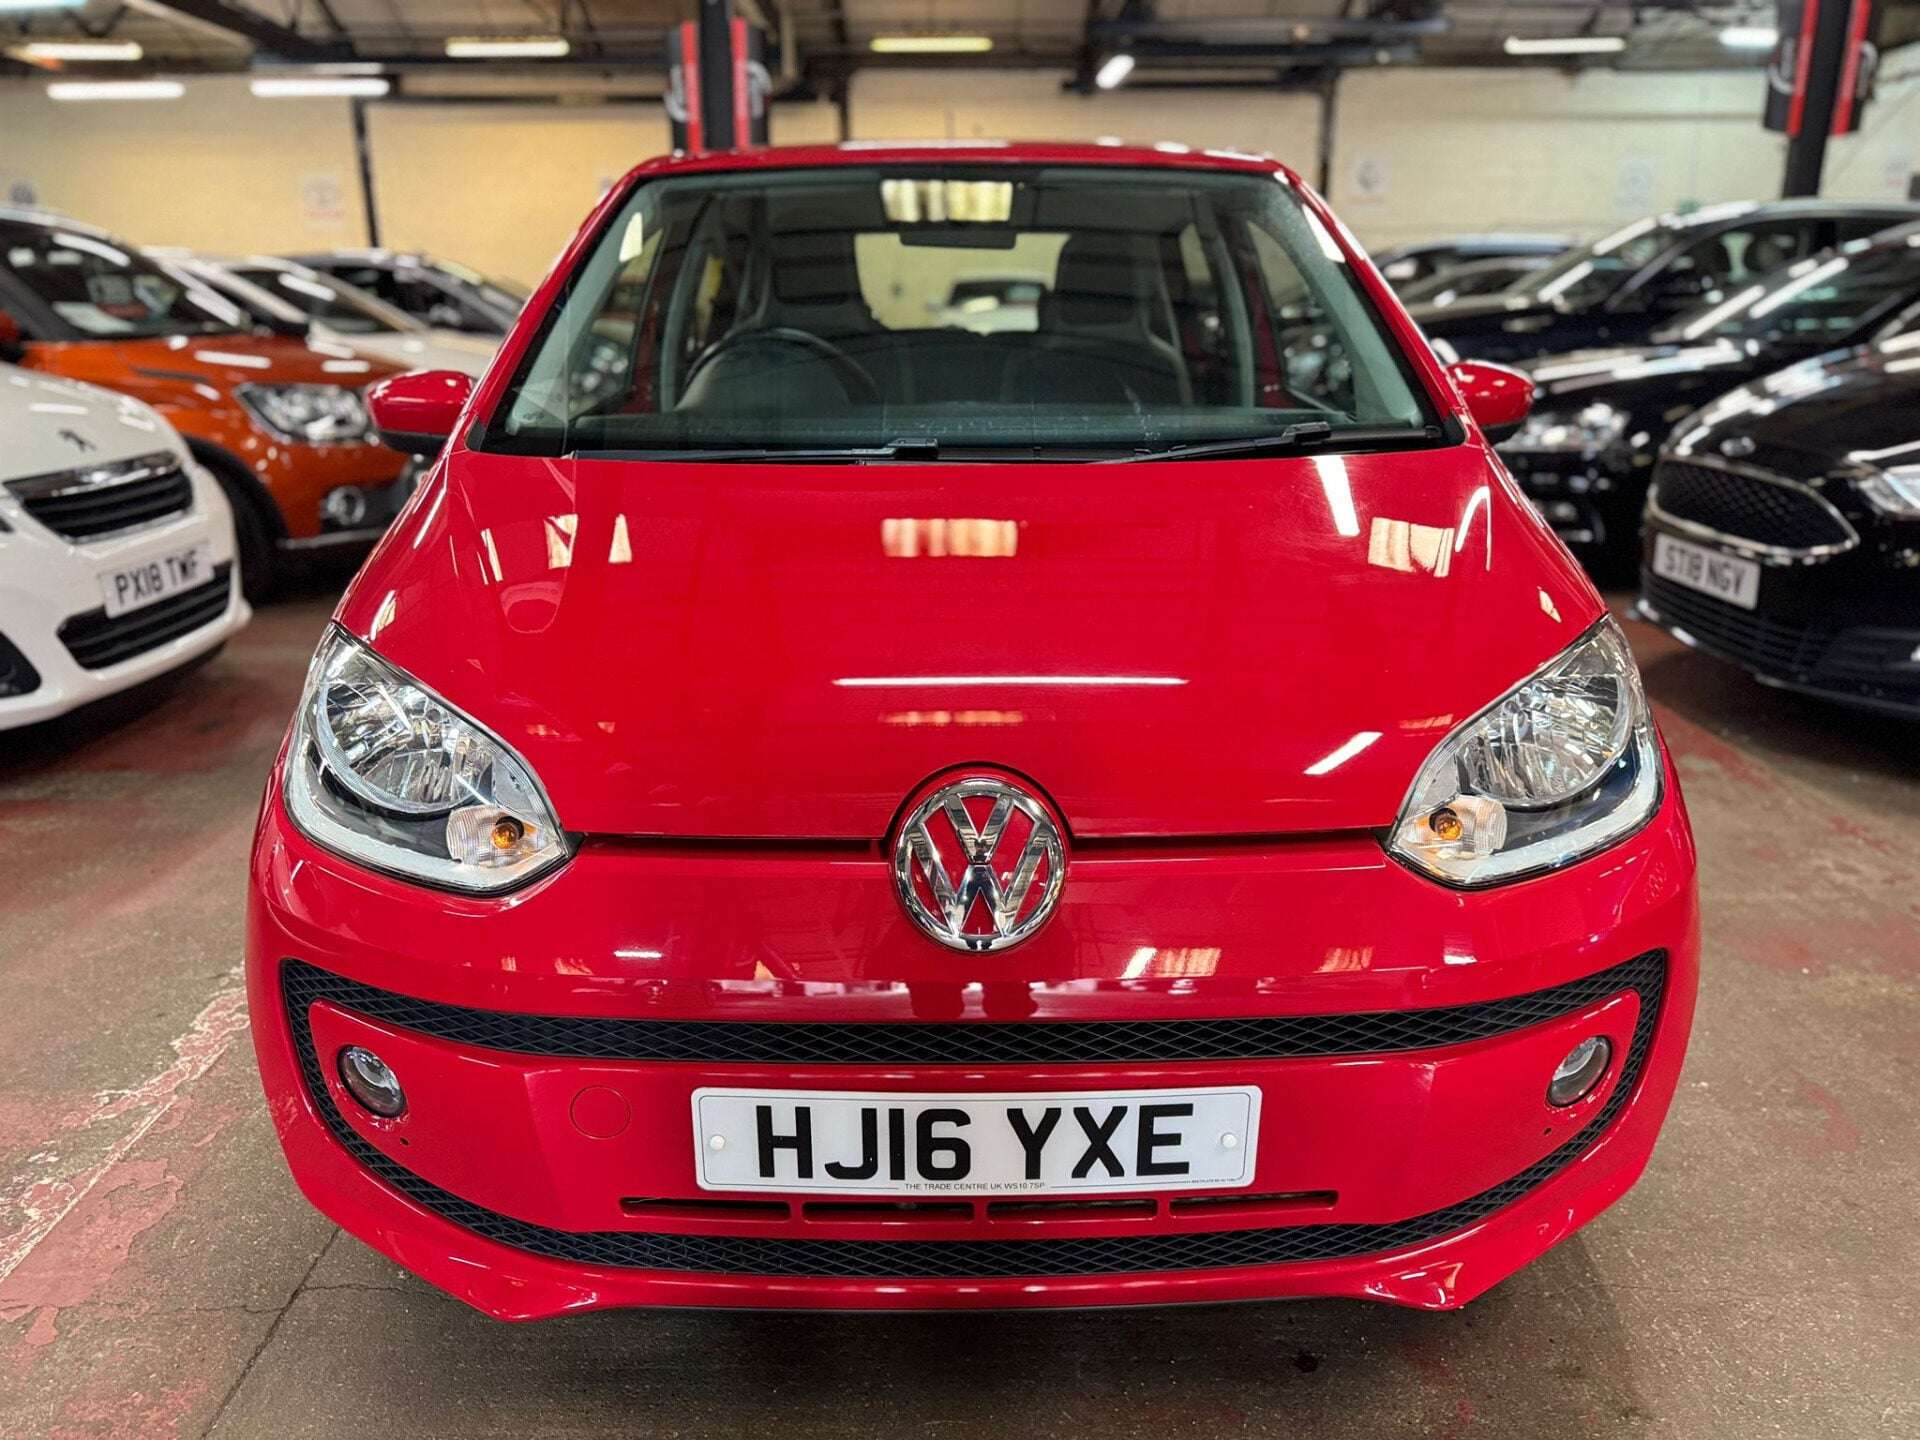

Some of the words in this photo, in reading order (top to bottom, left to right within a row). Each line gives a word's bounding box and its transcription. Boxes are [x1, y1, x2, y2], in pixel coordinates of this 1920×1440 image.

[756, 1105, 971, 1181] HJ16
[1006, 1103, 1194, 1180] YXE
[924, 1183, 951, 1191] TRADE
[990, 1182, 1001, 1190] UK
